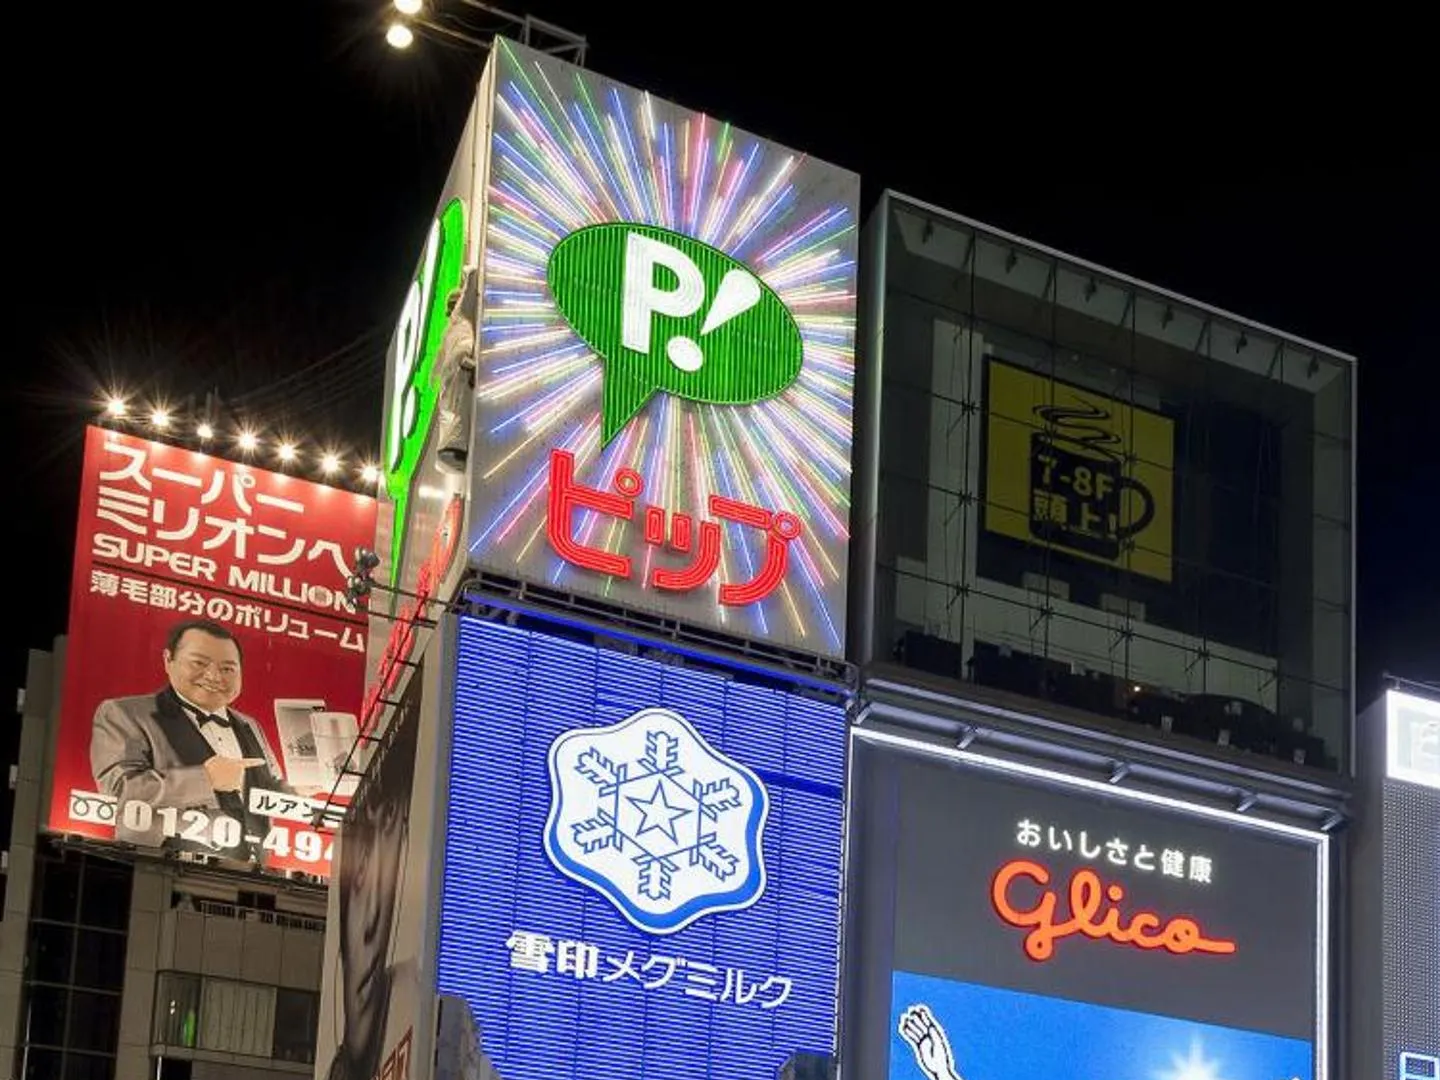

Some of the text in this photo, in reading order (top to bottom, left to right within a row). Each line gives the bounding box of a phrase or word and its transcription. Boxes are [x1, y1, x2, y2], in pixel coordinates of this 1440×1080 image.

[620, 231, 763, 373] P!
[100, 440, 305, 515] スーパー
[547, 448, 801, 607] ピップ
[90, 570, 367, 653] 薄毛部分のボリューム
[93, 533, 358, 616] SUPER MILLION
[124, 801, 334, 863] 0120-49
[1016, 819, 1214, 884] おいしさと健康
[991, 858, 1236, 962] Glico
[505, 930, 792, 1009] 雪印メグミルク
